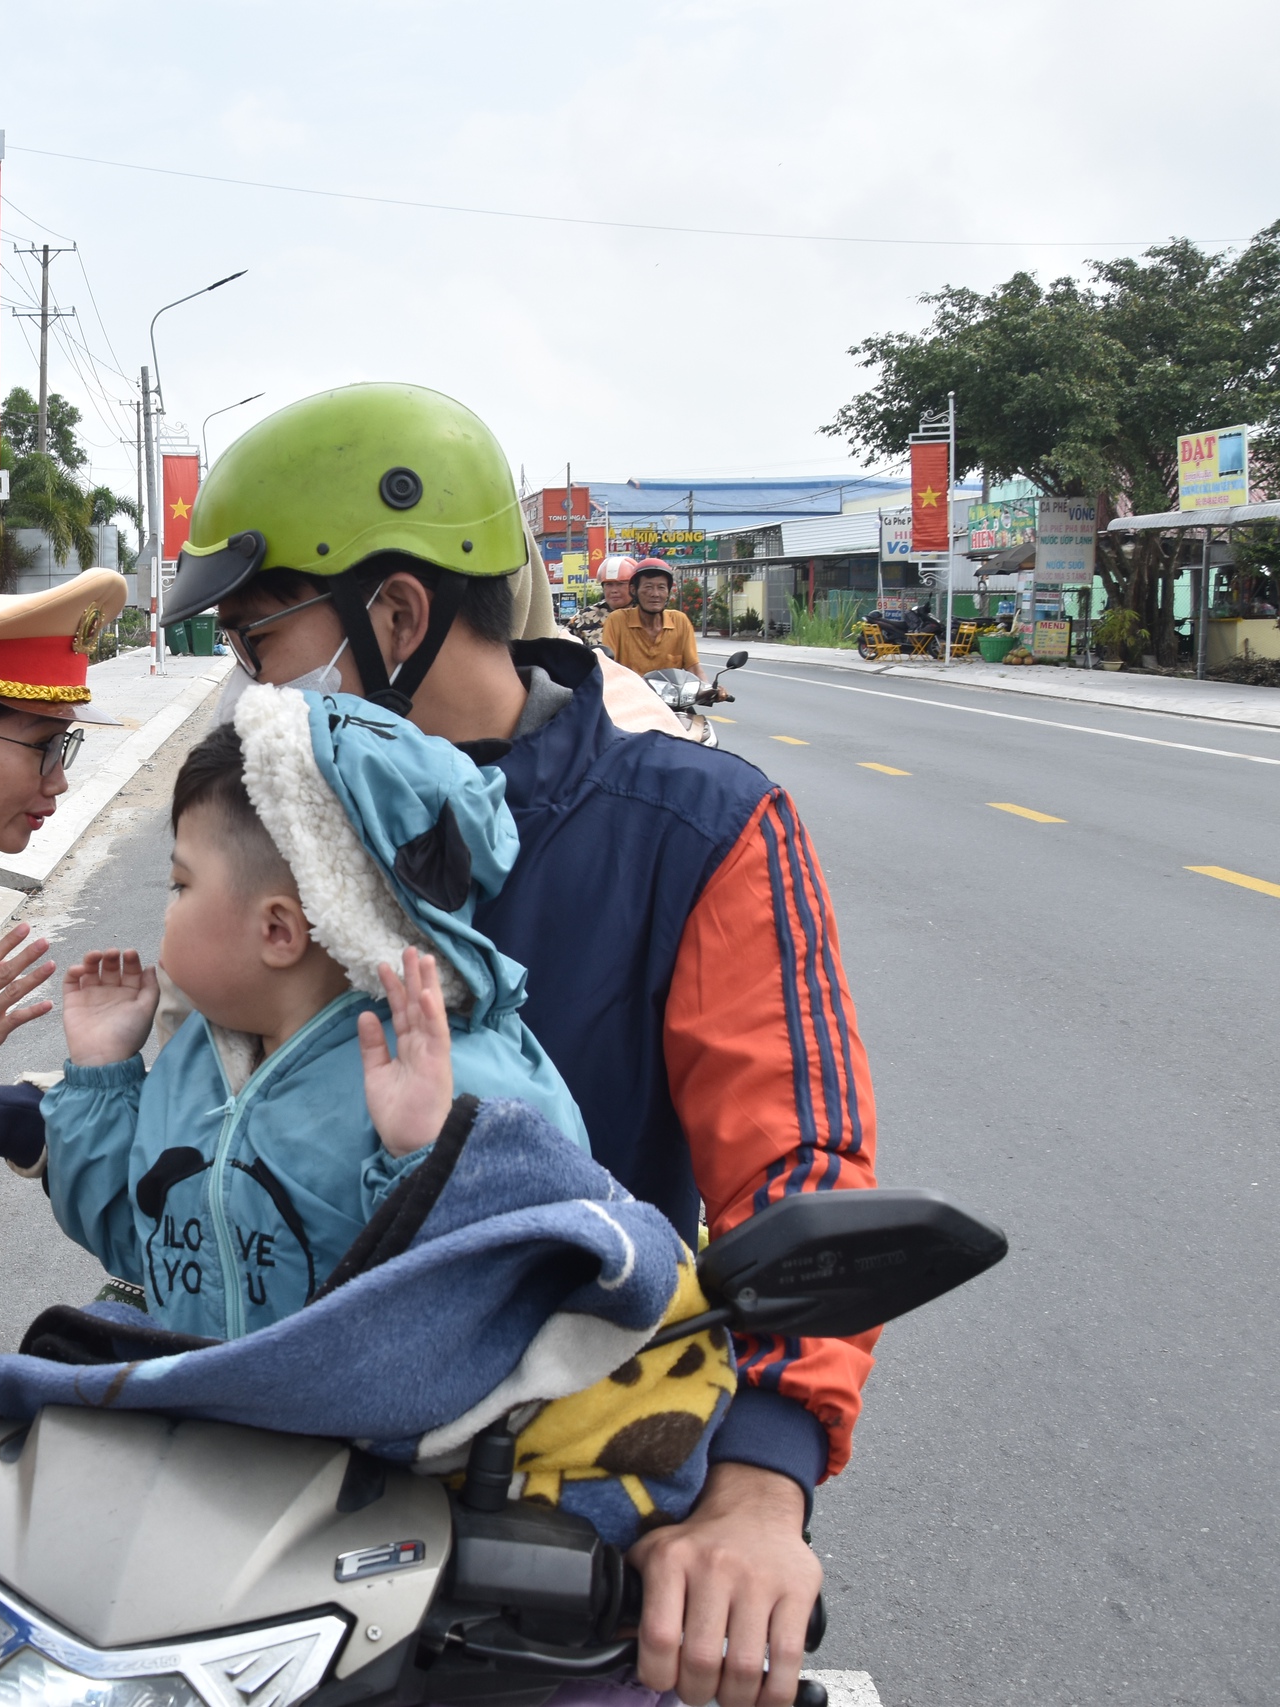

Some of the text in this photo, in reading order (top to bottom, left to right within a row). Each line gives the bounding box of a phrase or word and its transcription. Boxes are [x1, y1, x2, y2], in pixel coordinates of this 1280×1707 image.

[1181, 436, 1216, 466] ĐẠT
[1069, 504, 1095, 520] VÕNG
[636, 532, 658, 542] KIM
[1040, 622, 1066, 630] MENU
